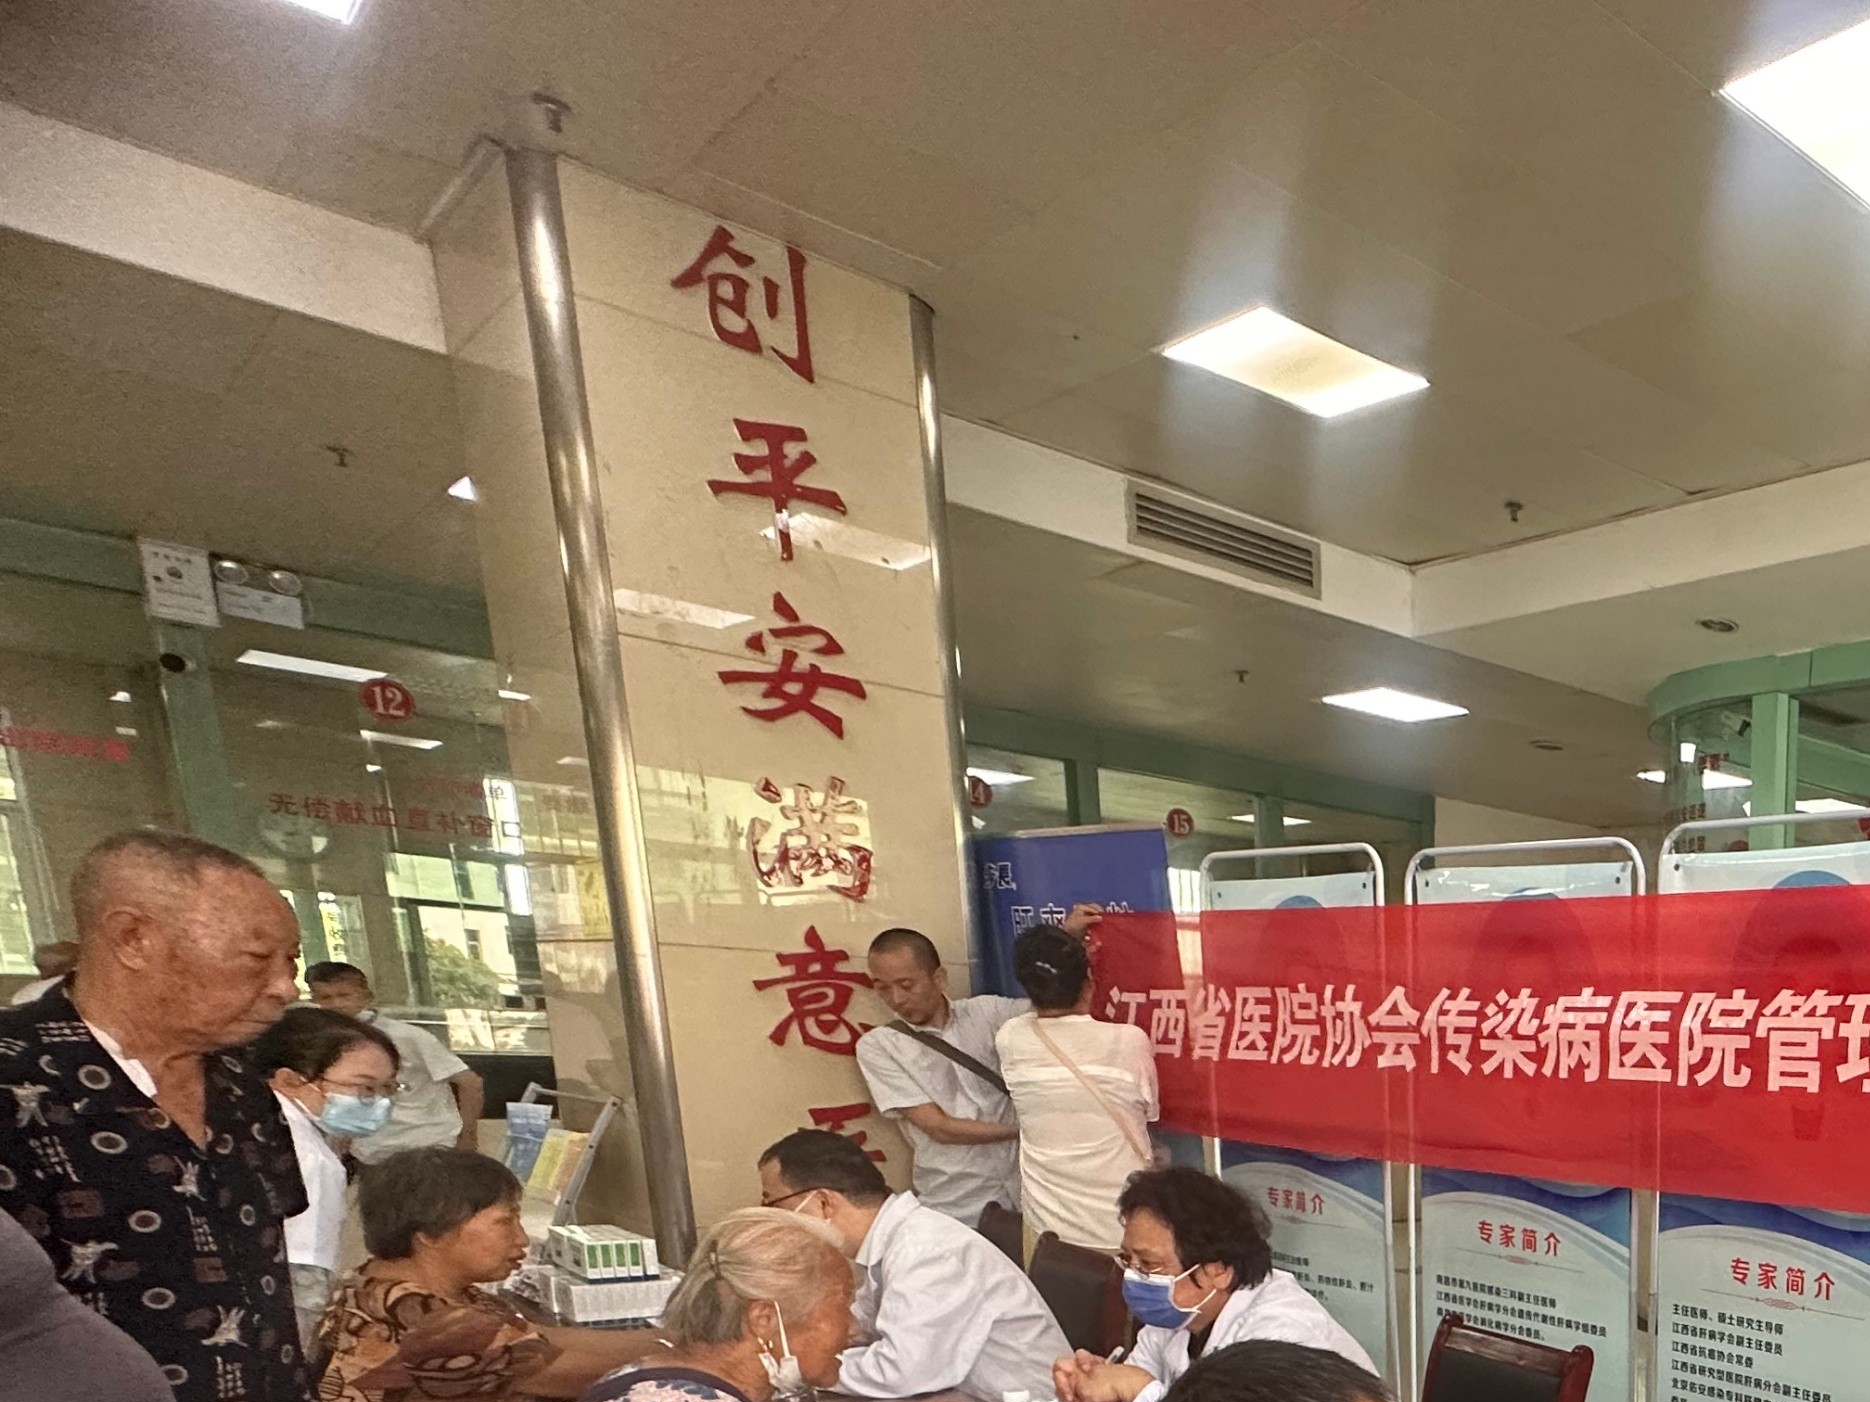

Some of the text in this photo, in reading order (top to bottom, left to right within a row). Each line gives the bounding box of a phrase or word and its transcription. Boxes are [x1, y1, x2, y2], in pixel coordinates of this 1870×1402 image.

[369, 685, 405, 717] 12
[1173, 814, 1191, 834] 15
[1267, 1186, 1325, 1216] 专家简介
[1478, 1220, 1561, 1257] 专家简介
[1730, 1257, 1835, 1301] 专家简介
[1672, 1303, 1784, 1336] 主任医师、硕士研究生导师
[1672, 1322, 1783, 1356] 江西省肝病学会副主任委员
[1672, 1341, 1754, 1369] 江西省抗癌协会常委
